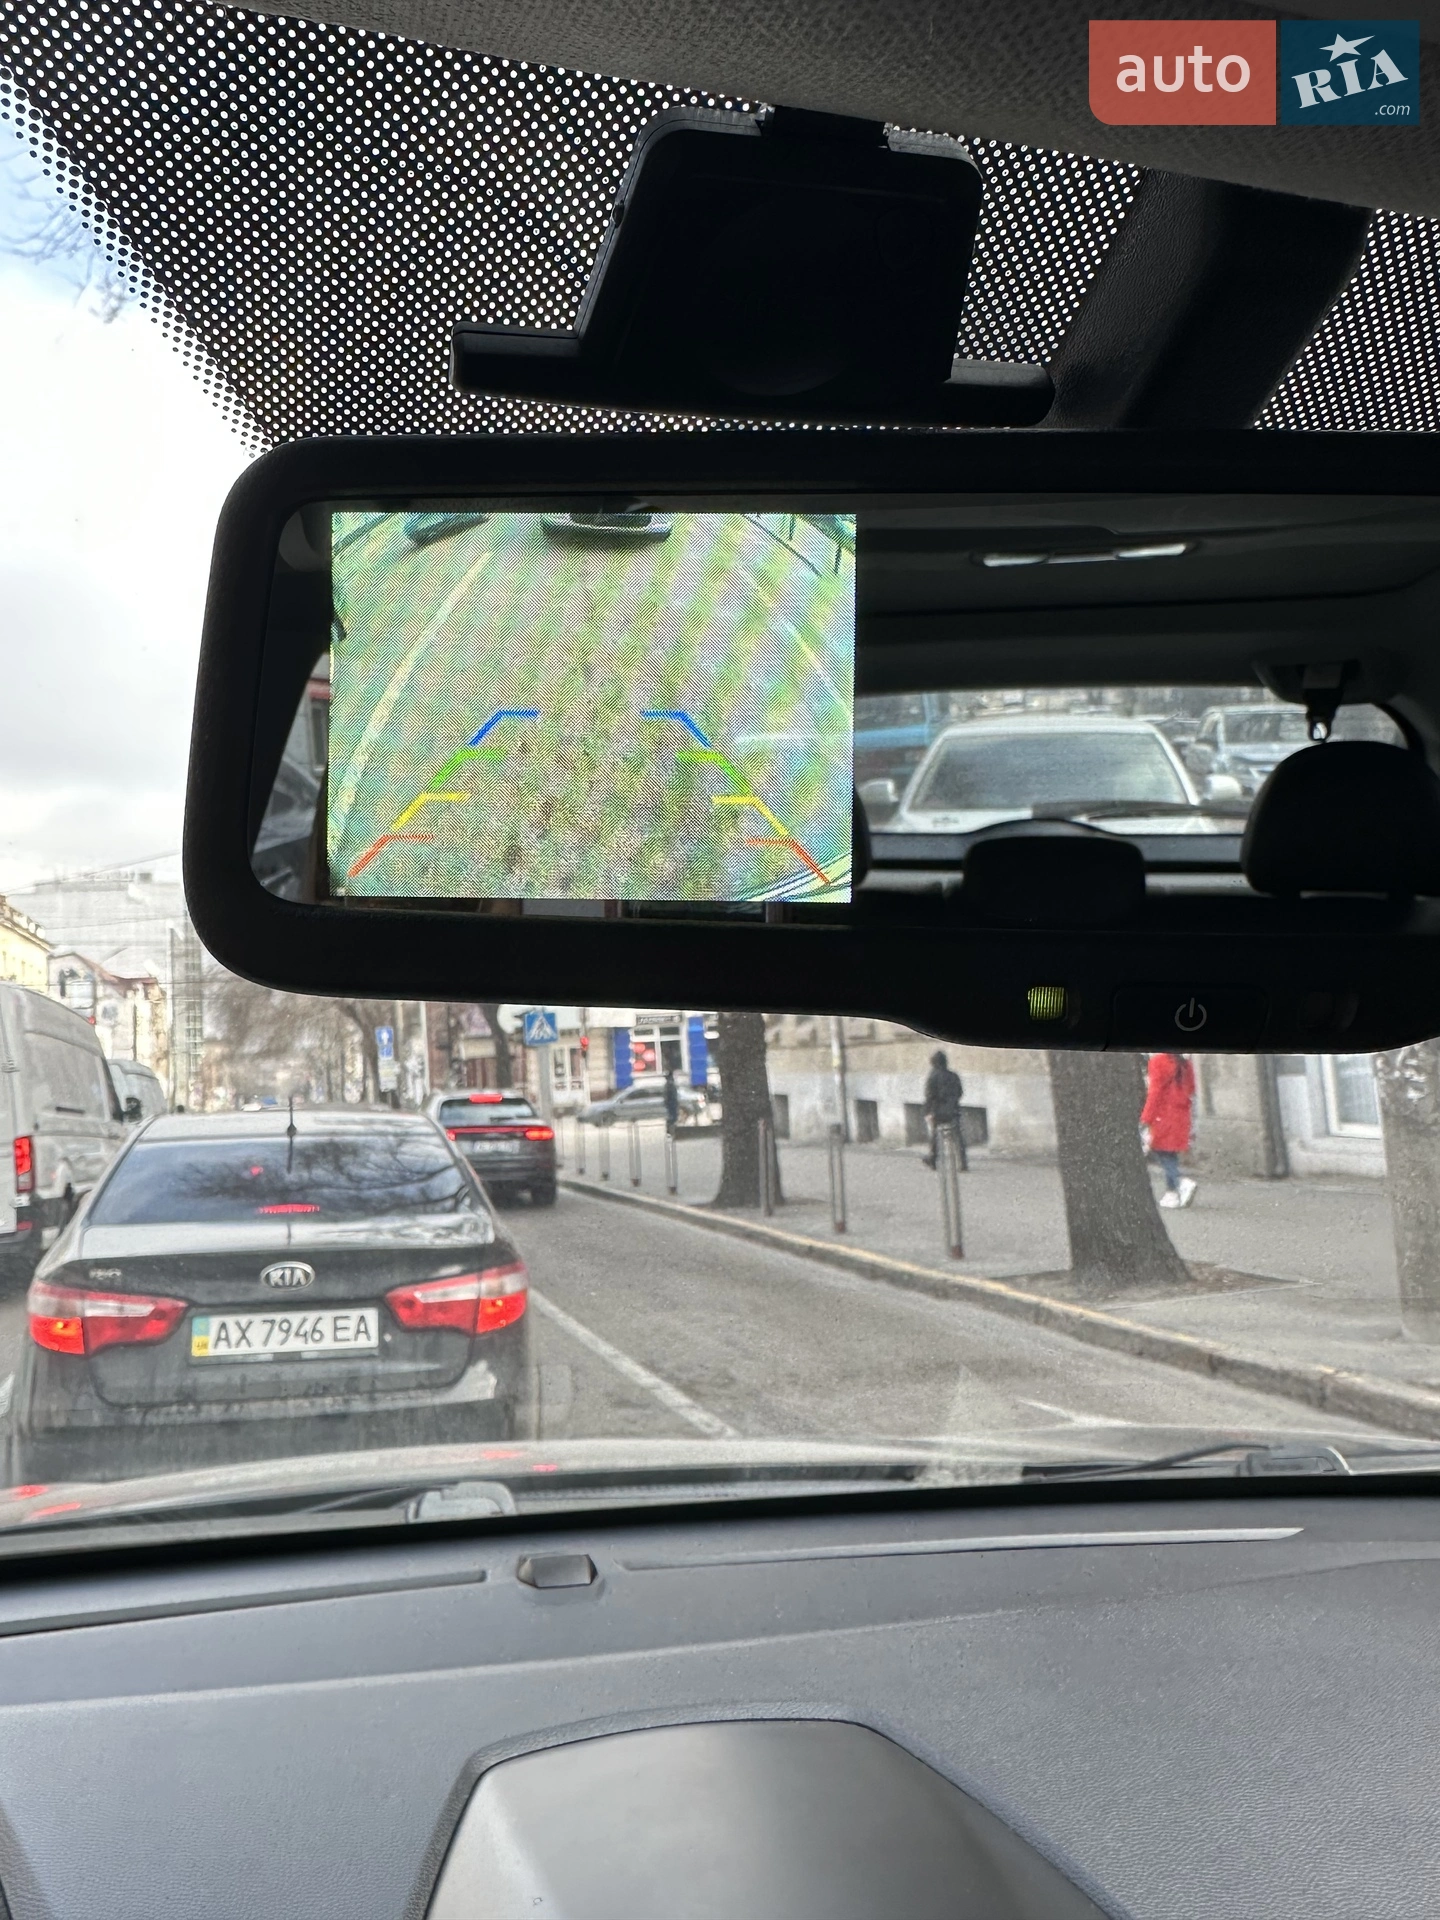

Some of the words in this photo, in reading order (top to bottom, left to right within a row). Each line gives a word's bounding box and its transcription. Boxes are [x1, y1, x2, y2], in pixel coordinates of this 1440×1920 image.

[268, 1268, 308, 1287] KIA
[214, 1320, 252, 1349] AX
[261, 1316, 325, 1346] 7946
[333, 1315, 371, 1342] EA
